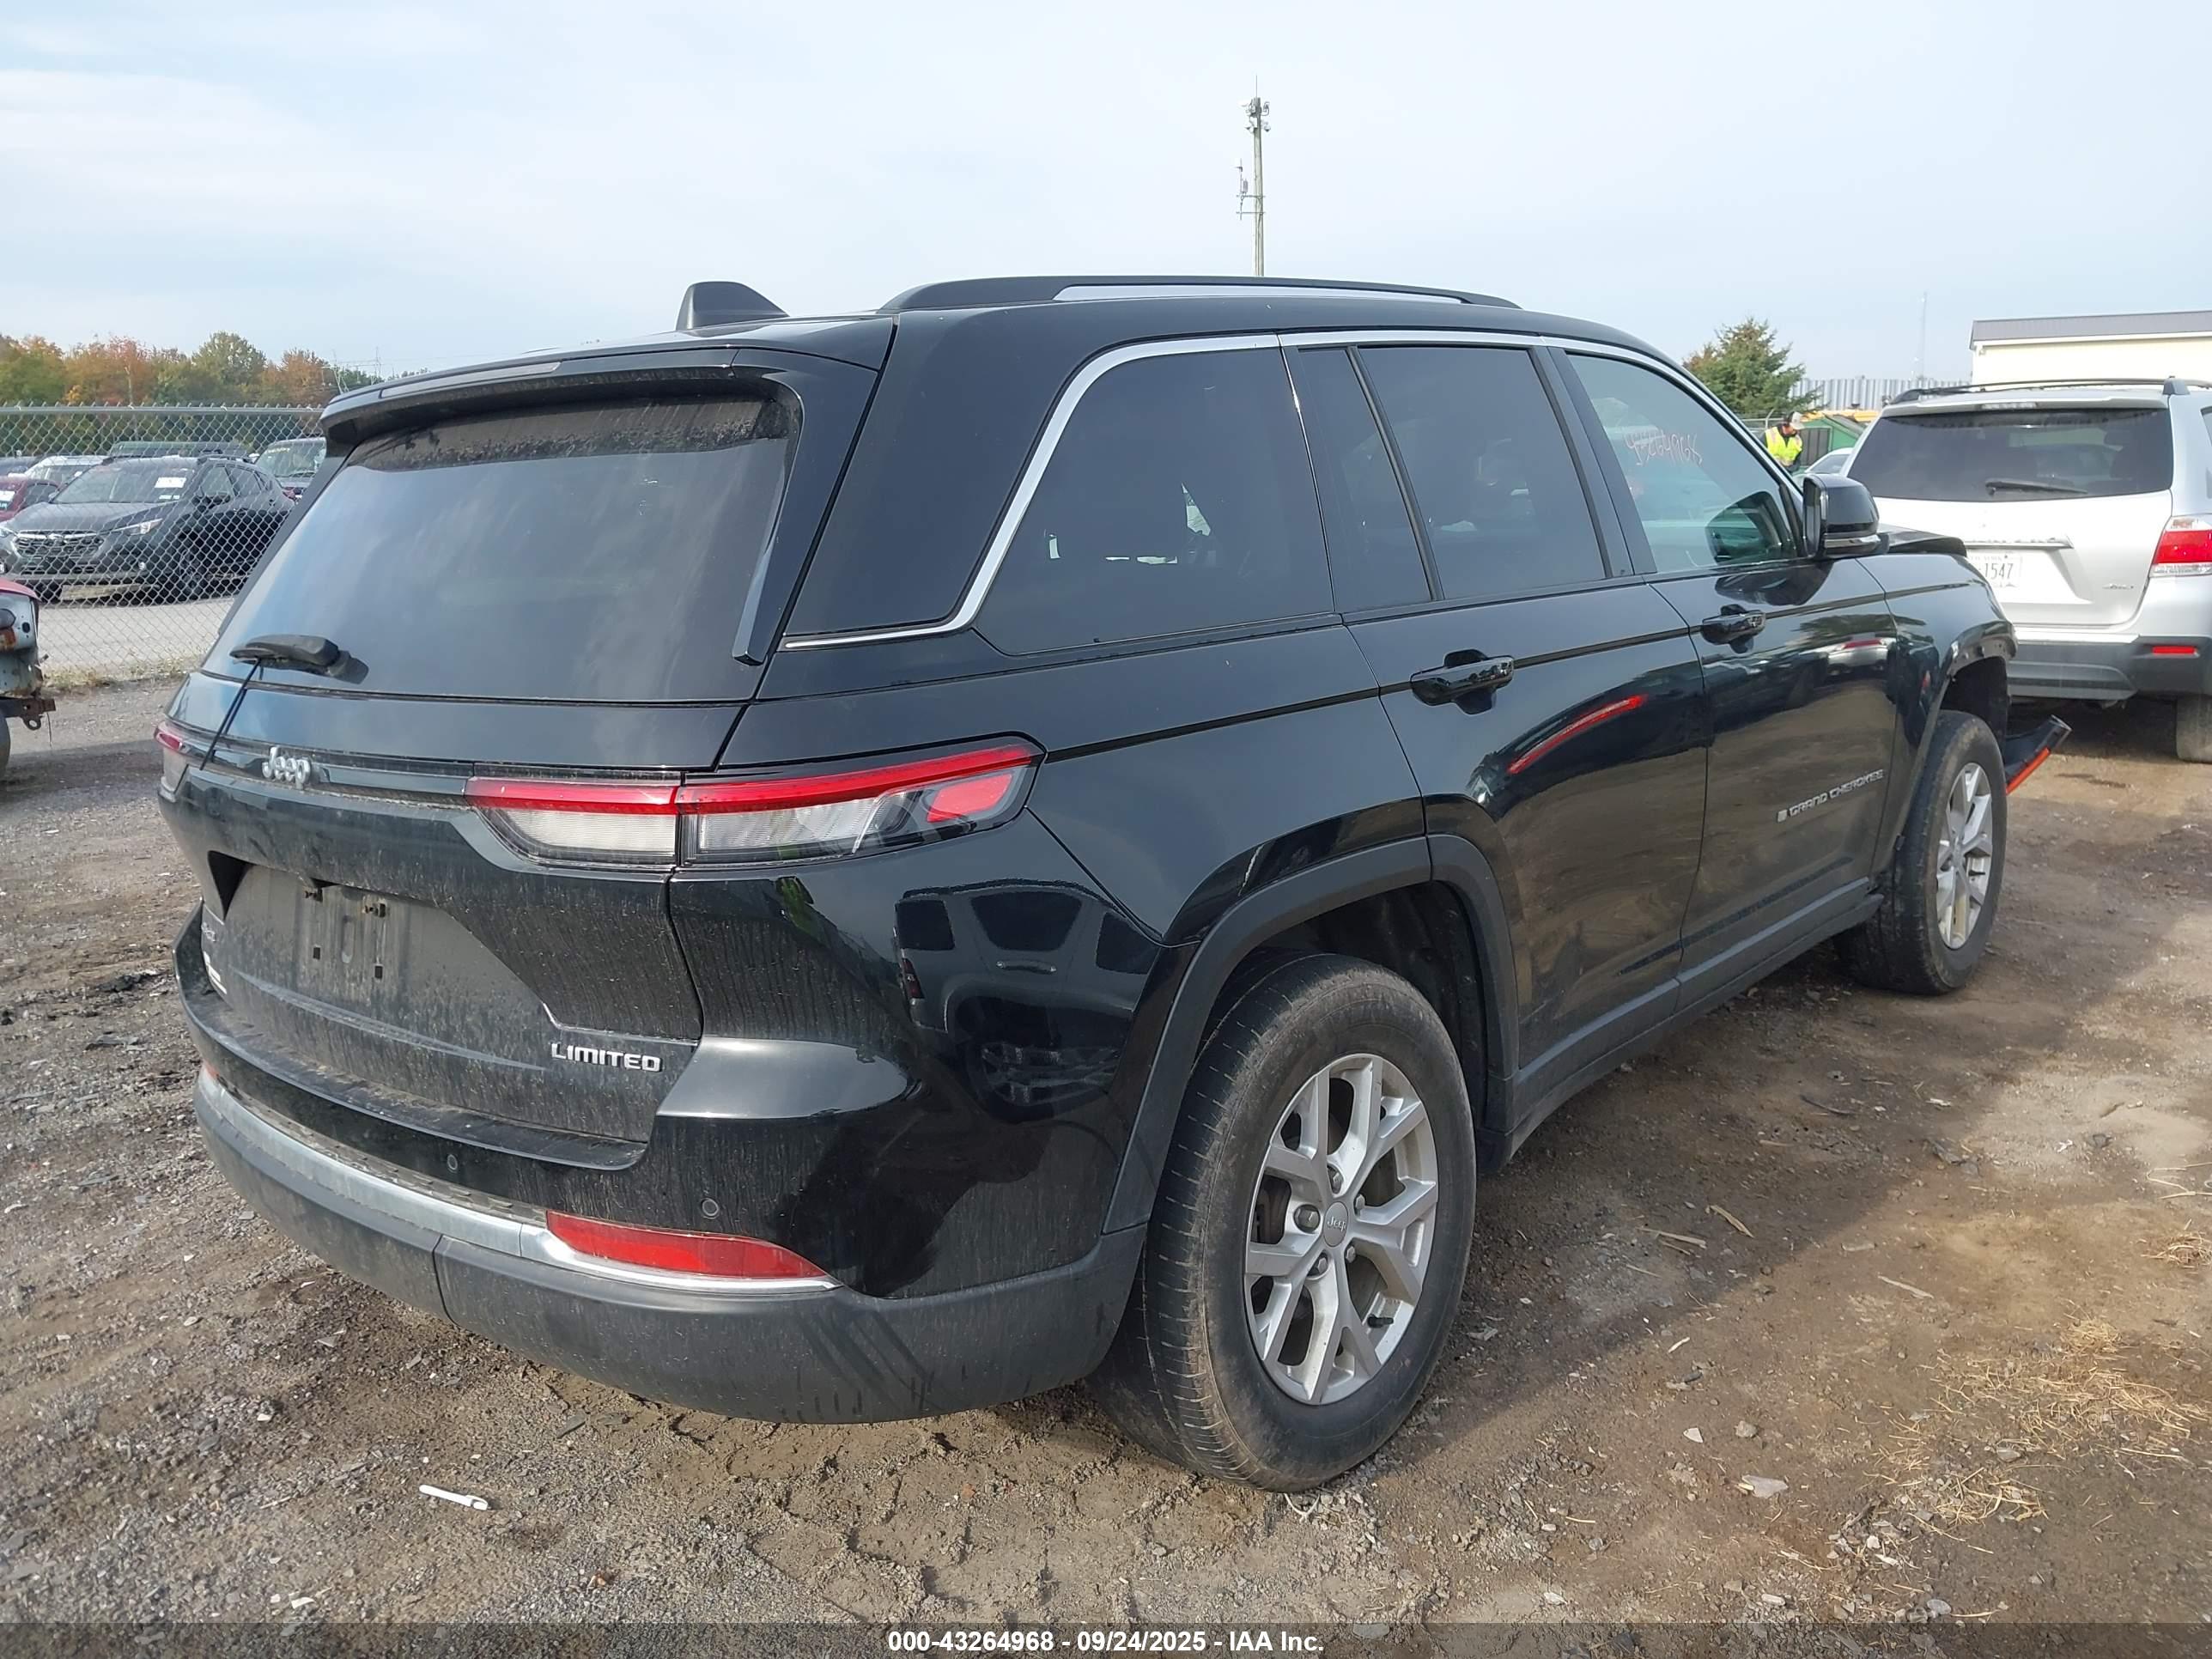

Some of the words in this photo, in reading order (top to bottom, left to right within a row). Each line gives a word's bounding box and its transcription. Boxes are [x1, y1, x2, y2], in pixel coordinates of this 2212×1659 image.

[1984, 562, 2014, 580] 1547
[261, 745, 311, 790] Jeep
[1789, 792, 1829, 817] GRAND
[1829, 769, 1884, 799] CHEROKEE
[550, 1042, 662, 1073] LIMITED
